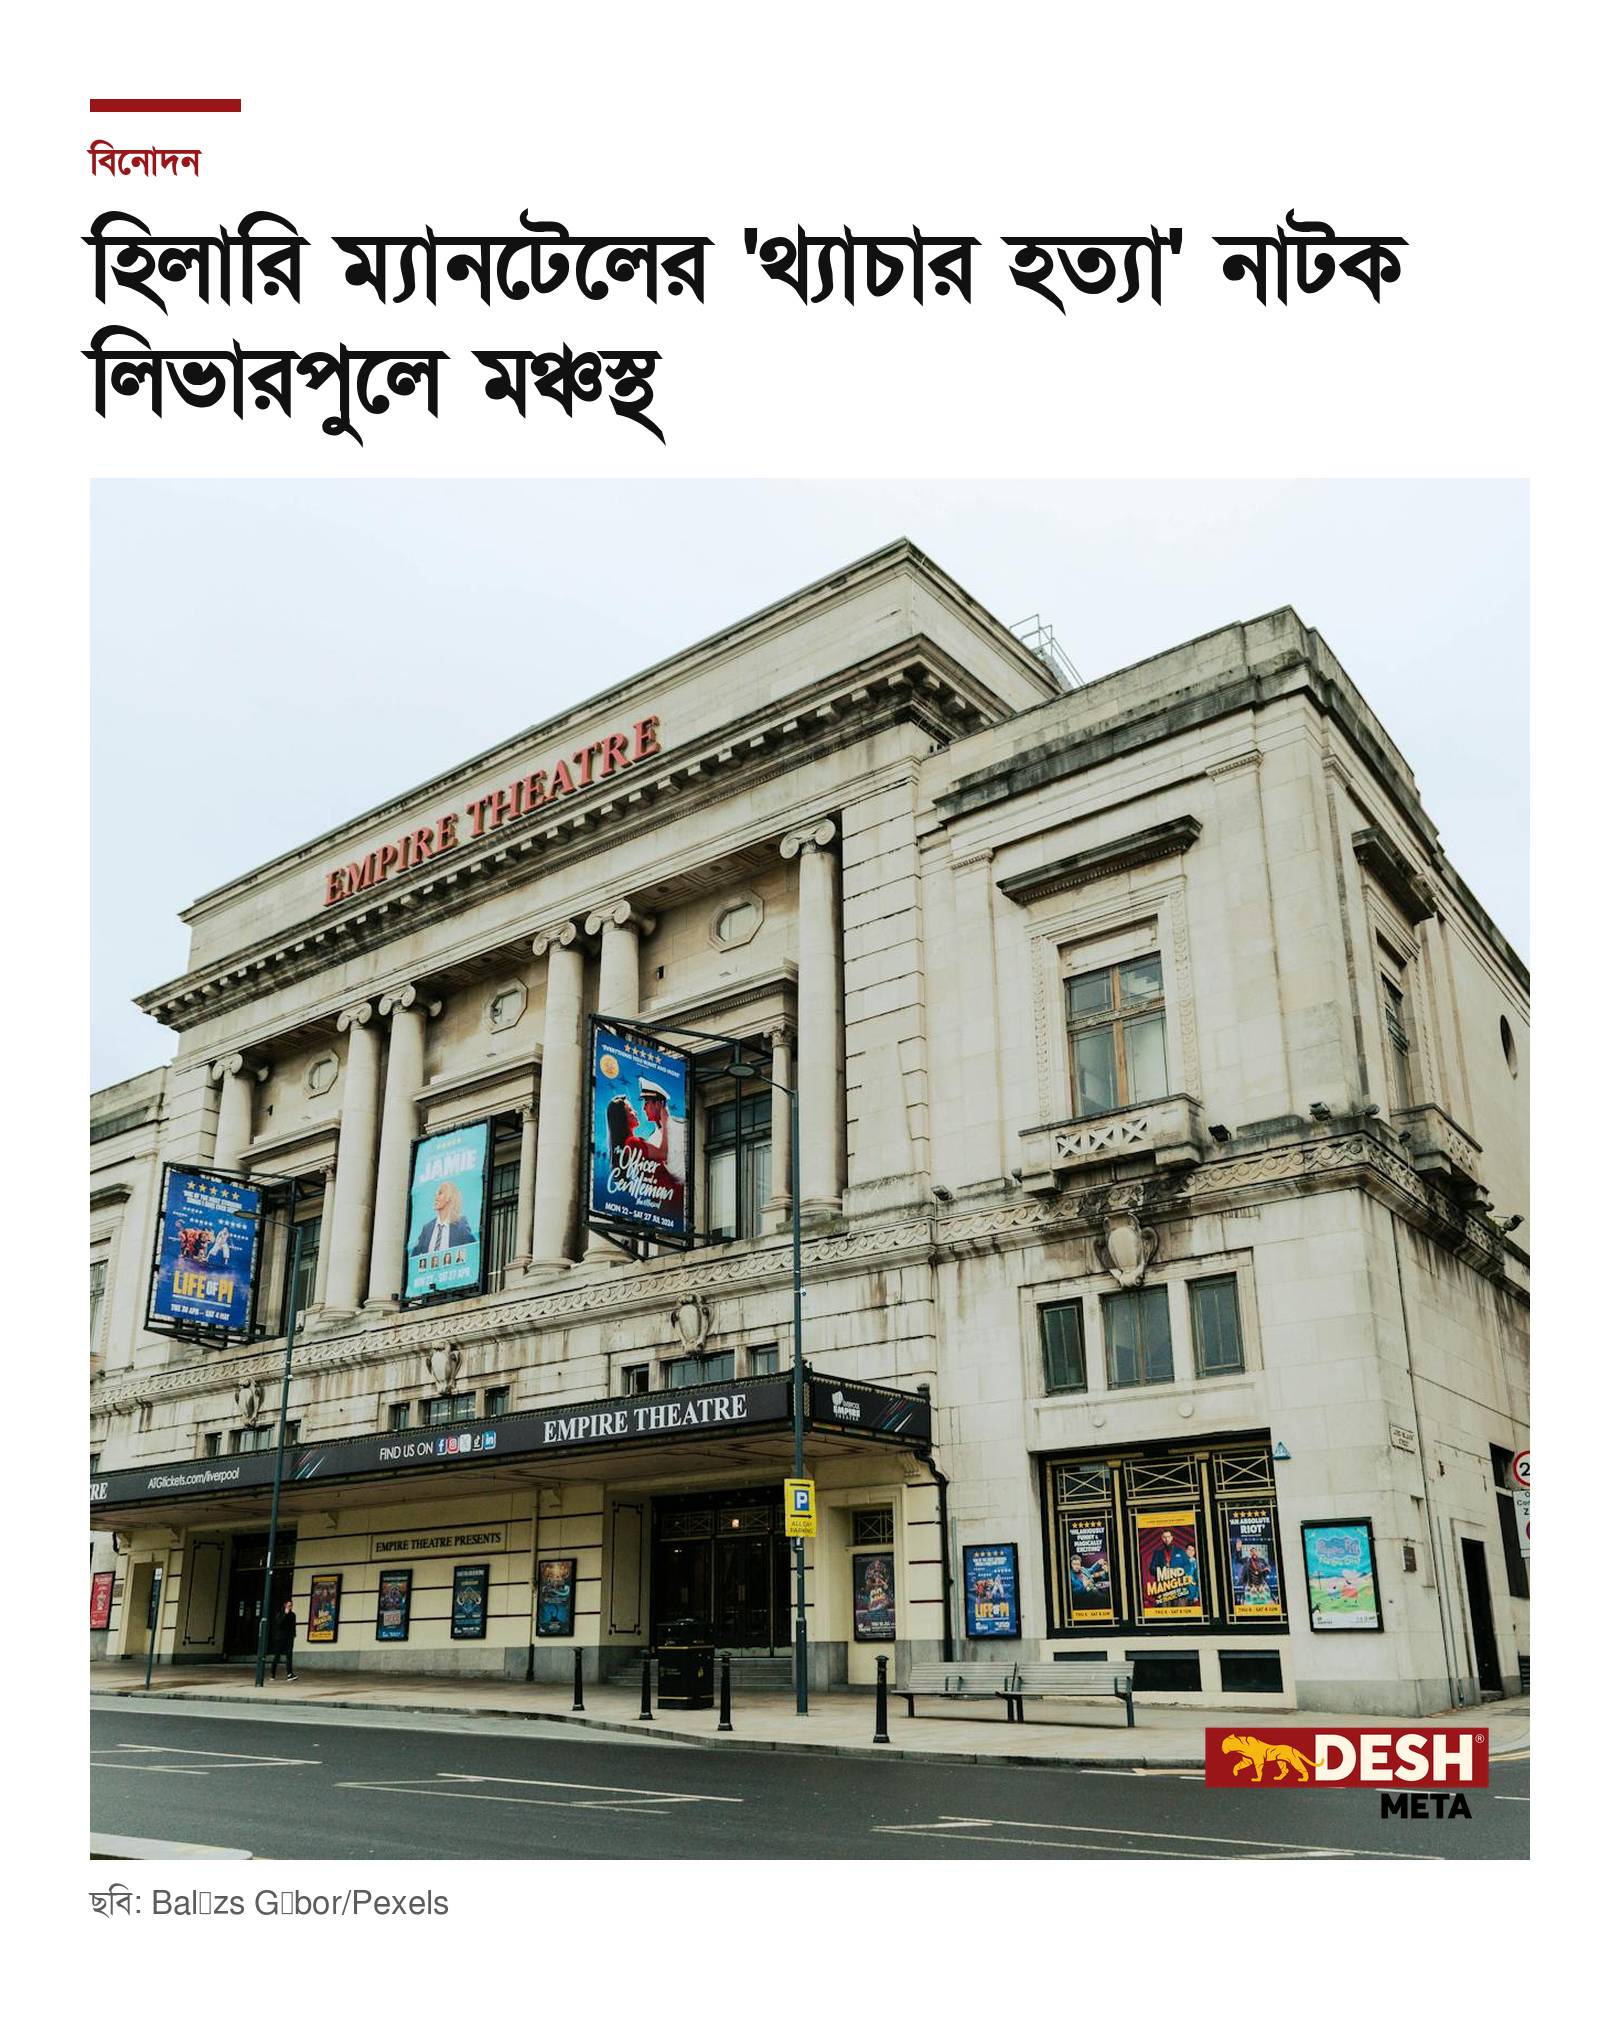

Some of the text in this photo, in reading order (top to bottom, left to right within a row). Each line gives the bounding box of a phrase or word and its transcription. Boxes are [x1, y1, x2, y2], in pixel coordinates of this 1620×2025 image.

[324, 715, 662, 907] EMPIRE THEATRE
[418, 1149, 477, 1183] JAMIE
[620, 1145, 661, 1179] Officer
[607, 1167, 674, 1201] Gentleman
[605, 1202, 620, 1213] MON
[633, 1209, 642, 1219] SAT
[173, 1270, 234, 1304] LIFE OF PI
[543, 1394, 748, 1443] EMPIRE THEATRE
[833, 1405, 860, 1417] EMPIRE
[379, 1441, 433, 1461] FIND US ON
[147, 1467, 240, 1490] ATGtickets.com/liverpool
[796, 1491, 808, 1510] P
[1240, 1516, 1270, 1524] ABSOLUTE
[376, 1532, 501, 1552] EMPIRE THEATRE PRESENTS
[1156, 1566, 1185, 1581] MIND
[1147, 1575, 1196, 1596] MANGLER
[975, 1602, 993, 1617] LIFE
